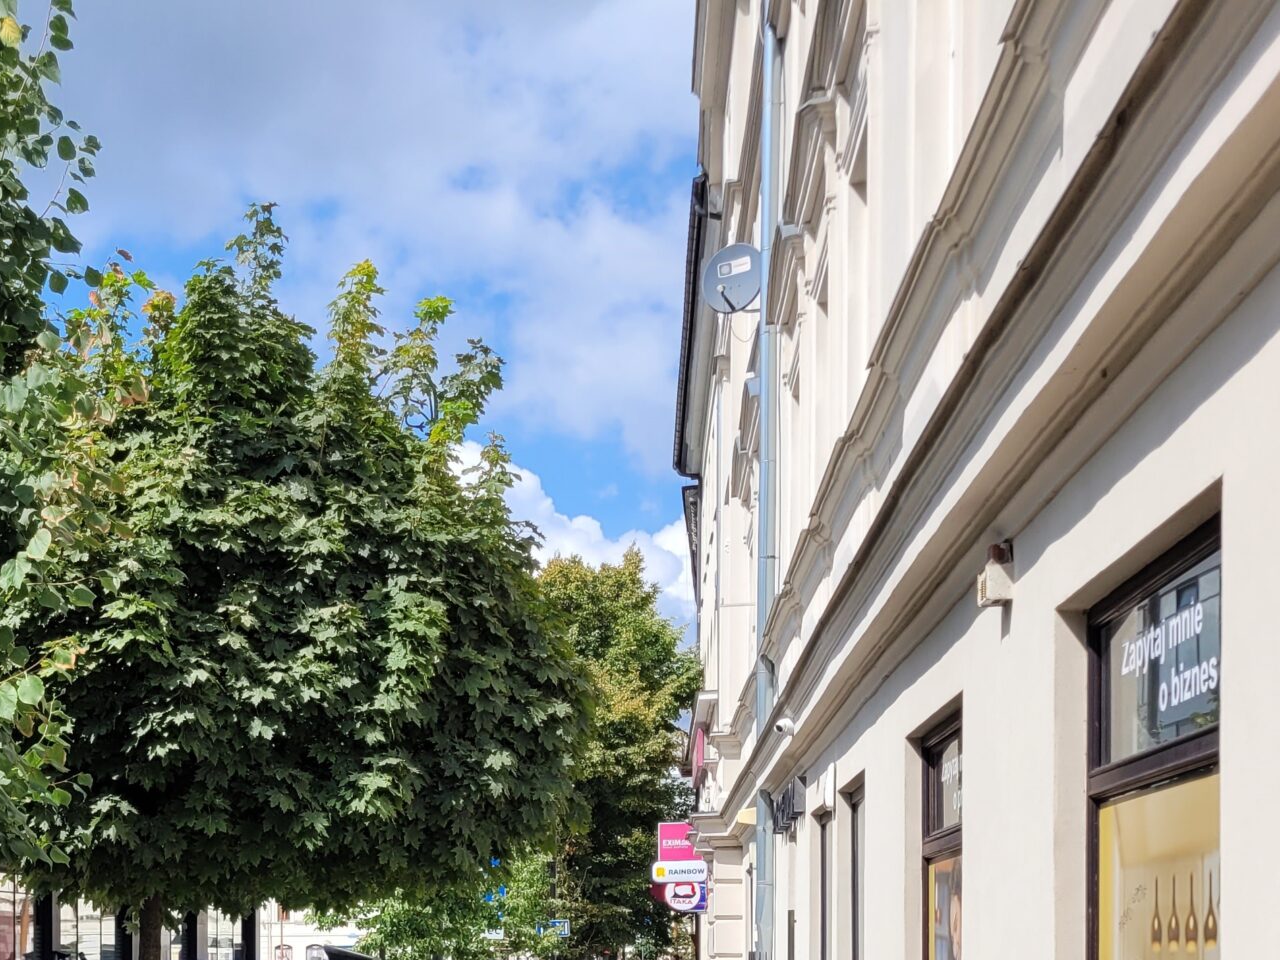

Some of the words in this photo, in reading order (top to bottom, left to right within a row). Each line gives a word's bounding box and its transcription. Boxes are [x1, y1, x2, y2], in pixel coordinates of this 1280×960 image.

[1121, 619, 1165, 678] Zapytaj
[1168, 596, 1203, 650] mnie
[1158, 681, 1167, 712] o
[1170, 657, 1218, 707] biznes
[668, 868, 705, 876] RAINBOW
